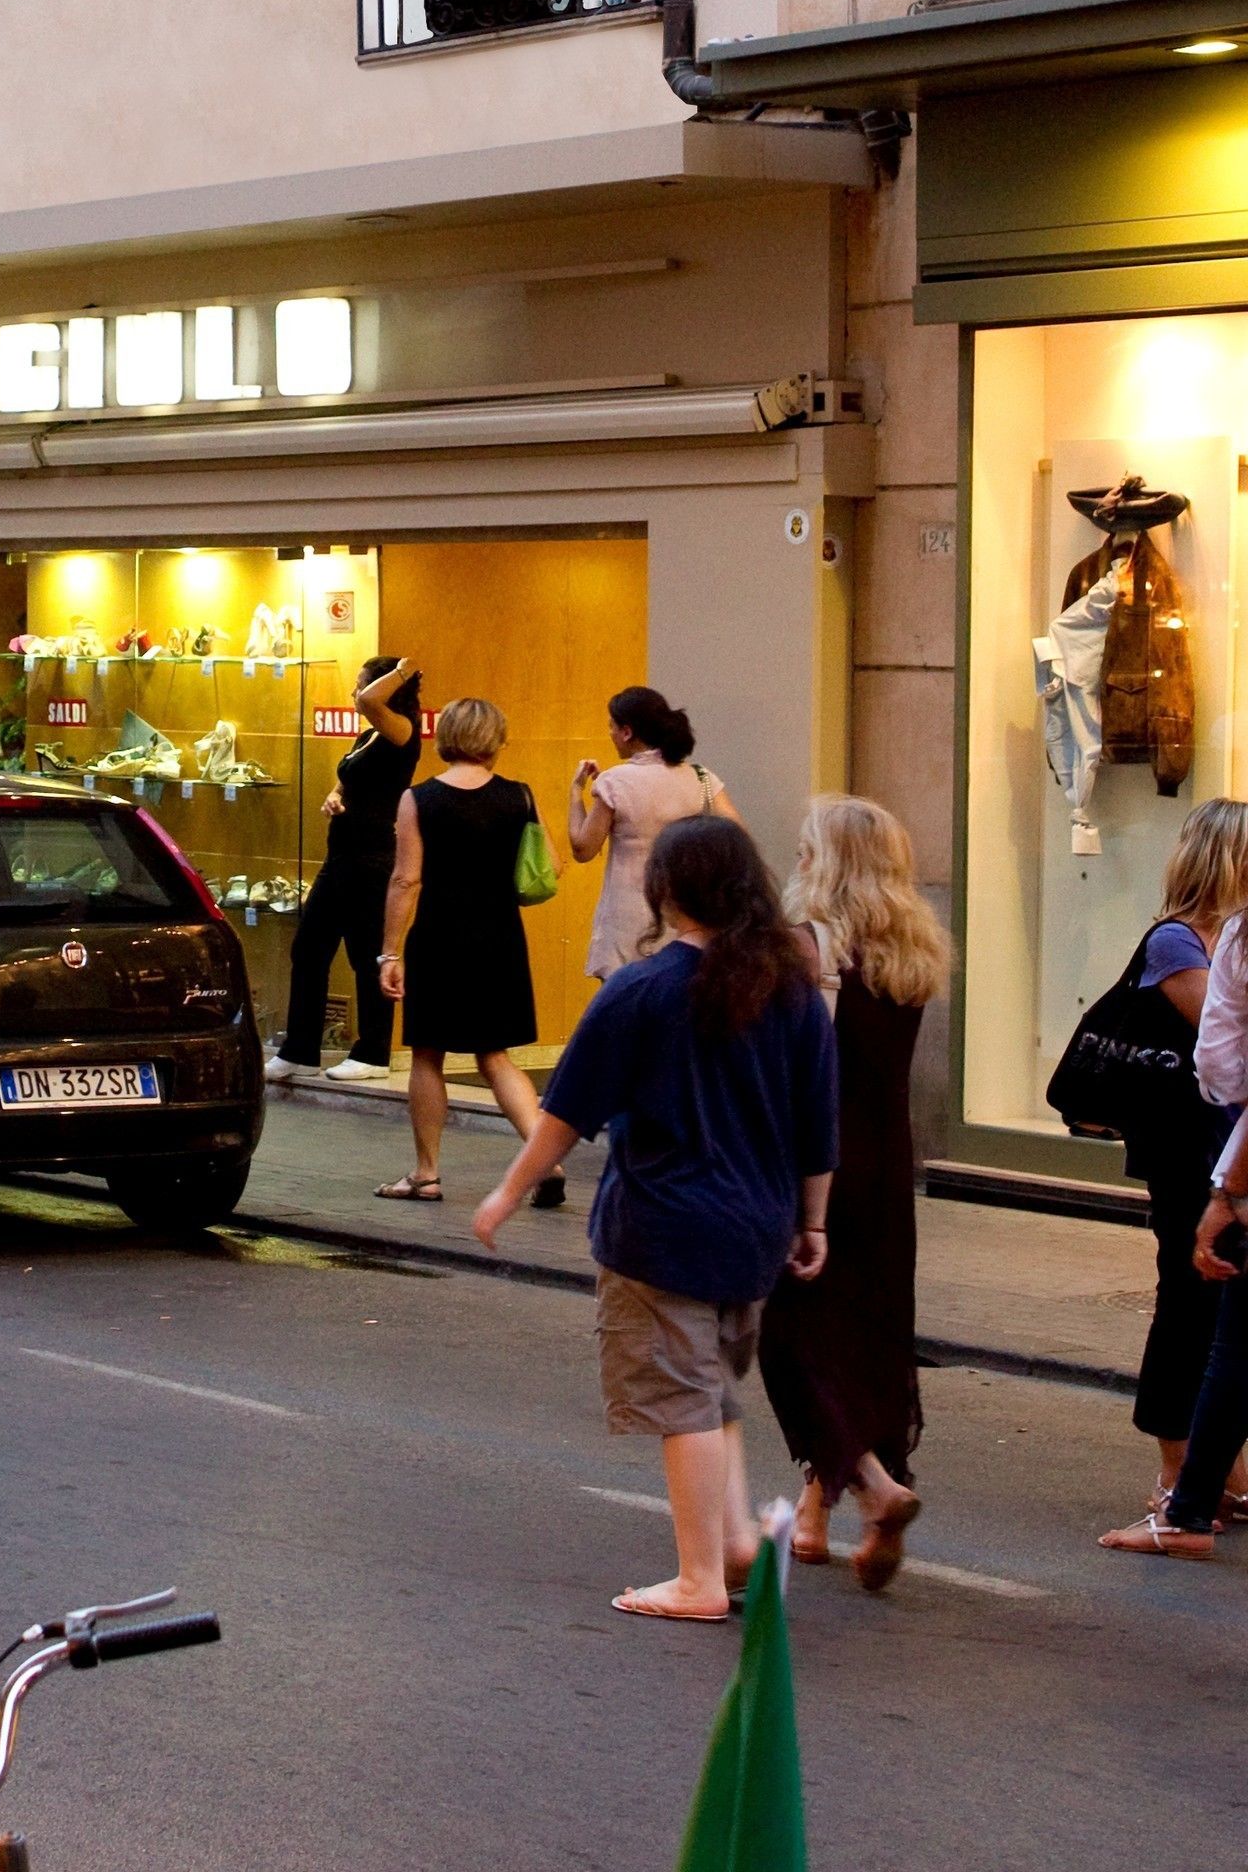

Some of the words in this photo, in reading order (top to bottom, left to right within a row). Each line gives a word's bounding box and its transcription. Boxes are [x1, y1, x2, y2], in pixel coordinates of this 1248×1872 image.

[920, 530, 951, 554] 124
[48, 702, 87, 723] SALDI
[314, 711, 360, 734] SALDI
[1078, 1031, 1181, 1068] PINKO
[18, 1070, 51, 1099] DN
[59, 1067, 140, 1097] 332SR
